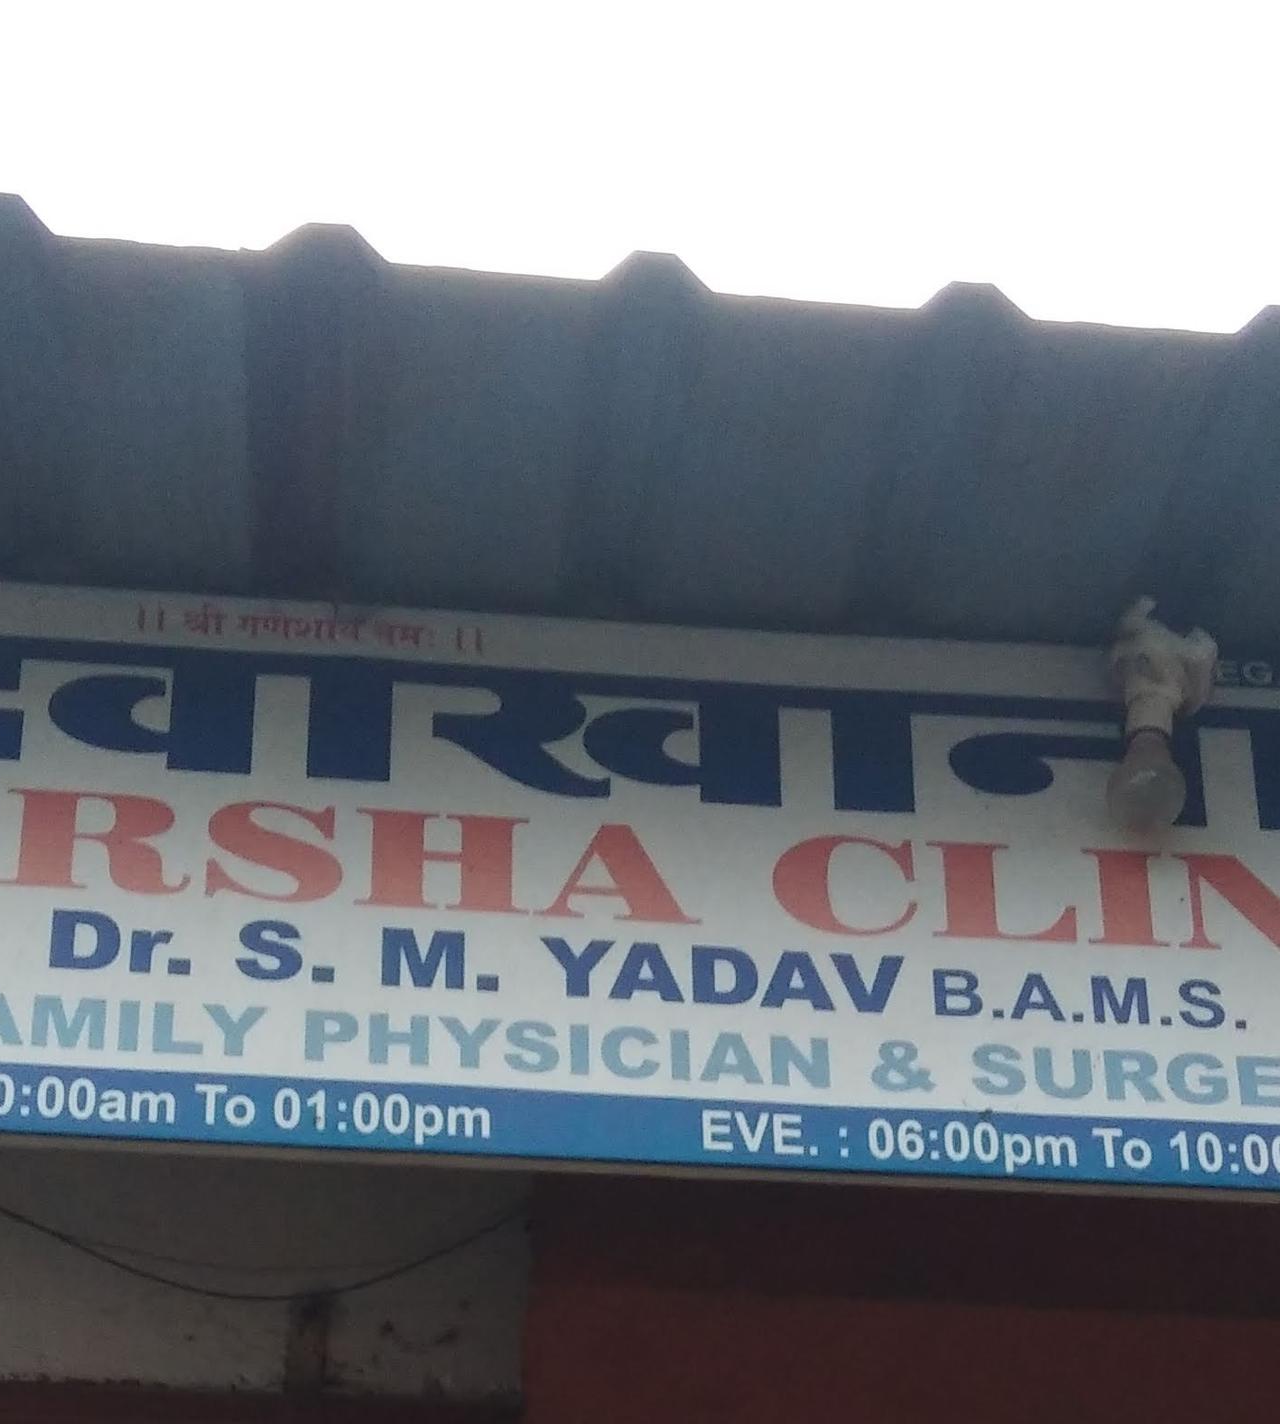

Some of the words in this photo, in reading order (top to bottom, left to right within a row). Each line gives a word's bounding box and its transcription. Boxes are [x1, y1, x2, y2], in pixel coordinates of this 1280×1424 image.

[49, 909, 192, 978] Dr.
[235, 919, 334, 985] S.
[381, 927, 500, 993] M.
[539, 938, 905, 1014] YADAV
[933, 968, 1247, 1030] B.A.M.S.
[304, 1010, 831, 1088] PHYSICIAN
[870, 1039, 936, 1092] &
[196, 1083, 256, 1128] To
[274, 1089, 492, 1145] 01:00pm
[702, 1109, 819, 1158] EVE.
[867, 1119, 1078, 1170] 06:00pm
[1092, 1127, 1153, 1168] To
